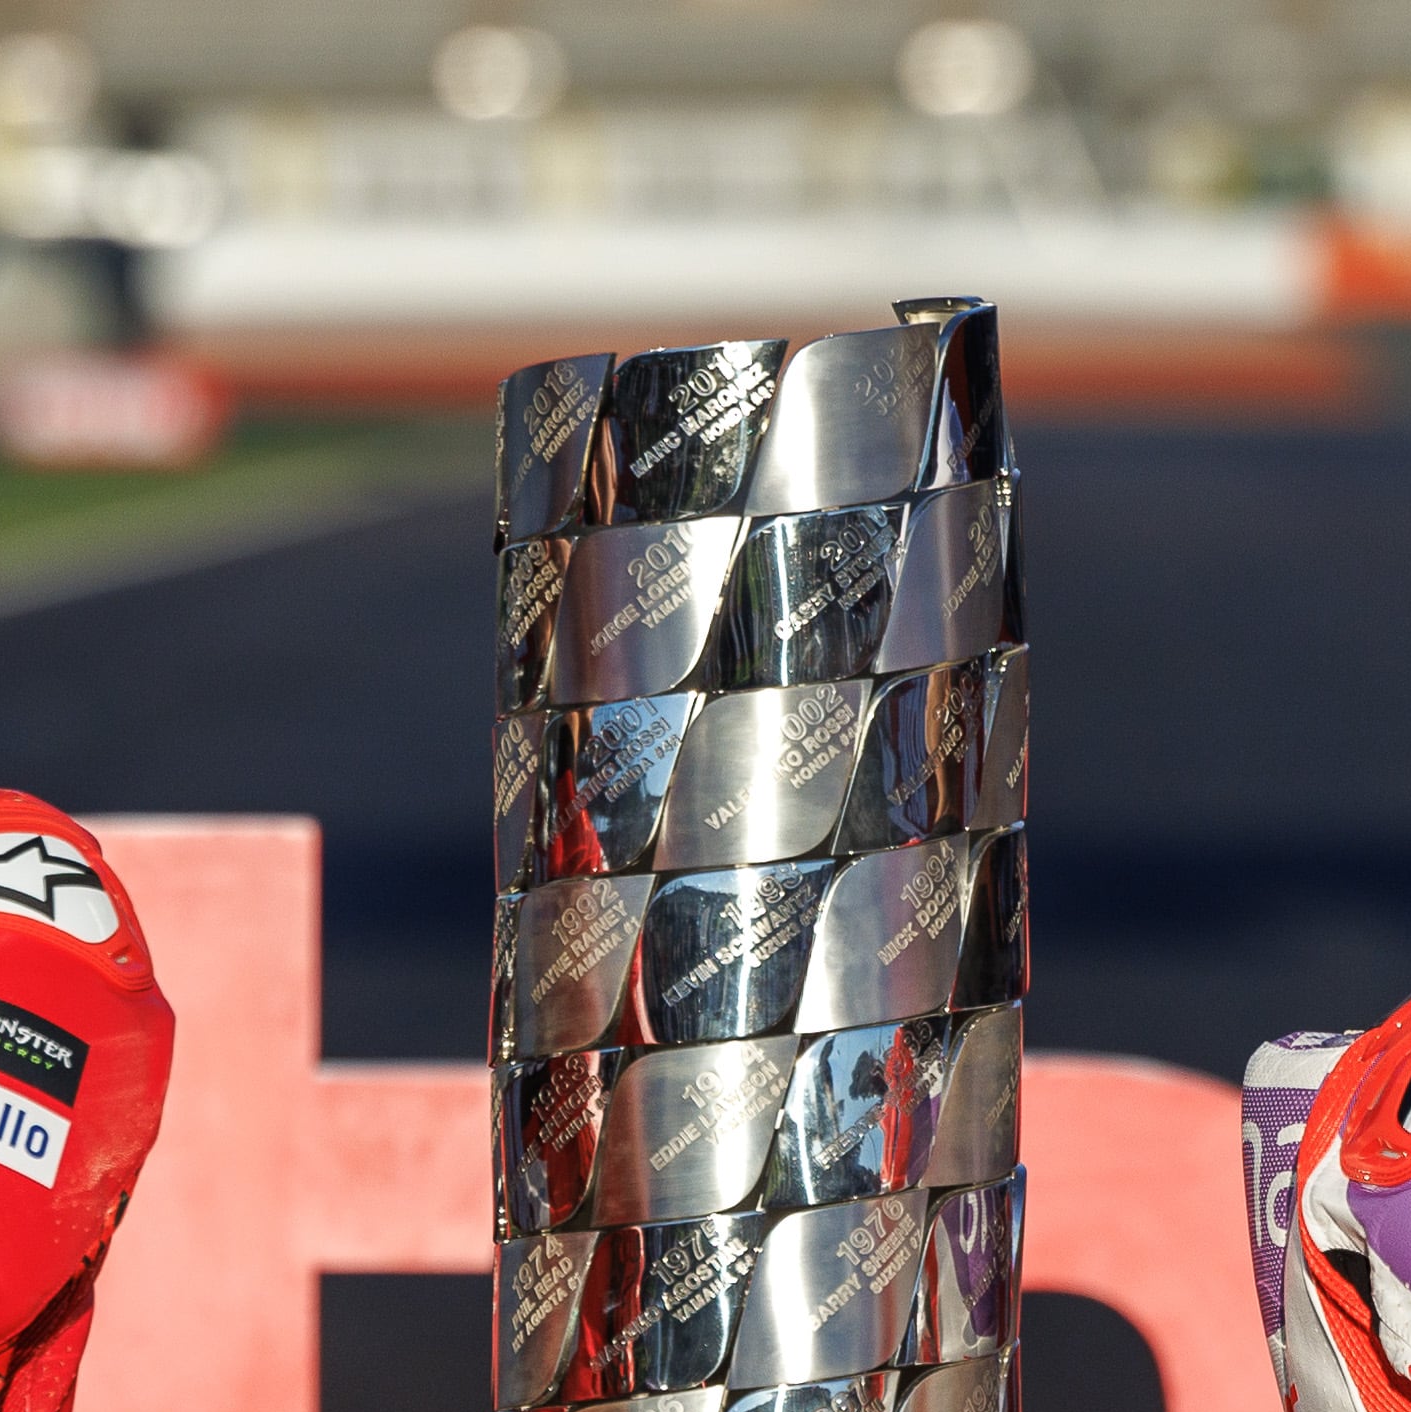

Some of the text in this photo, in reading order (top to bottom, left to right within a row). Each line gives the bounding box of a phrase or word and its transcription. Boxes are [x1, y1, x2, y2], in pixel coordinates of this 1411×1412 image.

[524, 360, 578, 436] 2018
[530, 378, 589, 455] MARQUEZ
[630, 431, 682, 478] MARC
[590, 603, 641, 657] JORGE
[774, 582, 836, 641] CASEY
[585, 696, 659, 769] 2001
[780, 682, 844, 741] 002
[802, 704, 856, 751] ROSSI
[789, 743, 841, 790] HONDA
[900, 839, 957, 910] 1994
[551, 877, 619, 947] 1992
[531, 900, 628, 1005] WAYNE RAINEY
[567, 931, 623, 983] YAMAHA
[876, 921, 920, 967] MICK
[661, 958, 720, 1008] KEVIN
[531, 1054, 588, 1123] 1983
[649, 1122, 702, 1172] EDDIE
[836, 1197, 905, 1267] 1976
[511, 1256, 573, 1331] PHIL READ
[512, 1235, 566, 1301] 1974
[810, 1213, 917, 1333] BARRY SHEENE
[869, 1250, 911, 1296] SUZUKI
[524, 1289, 570, 1331] AGUSTA
